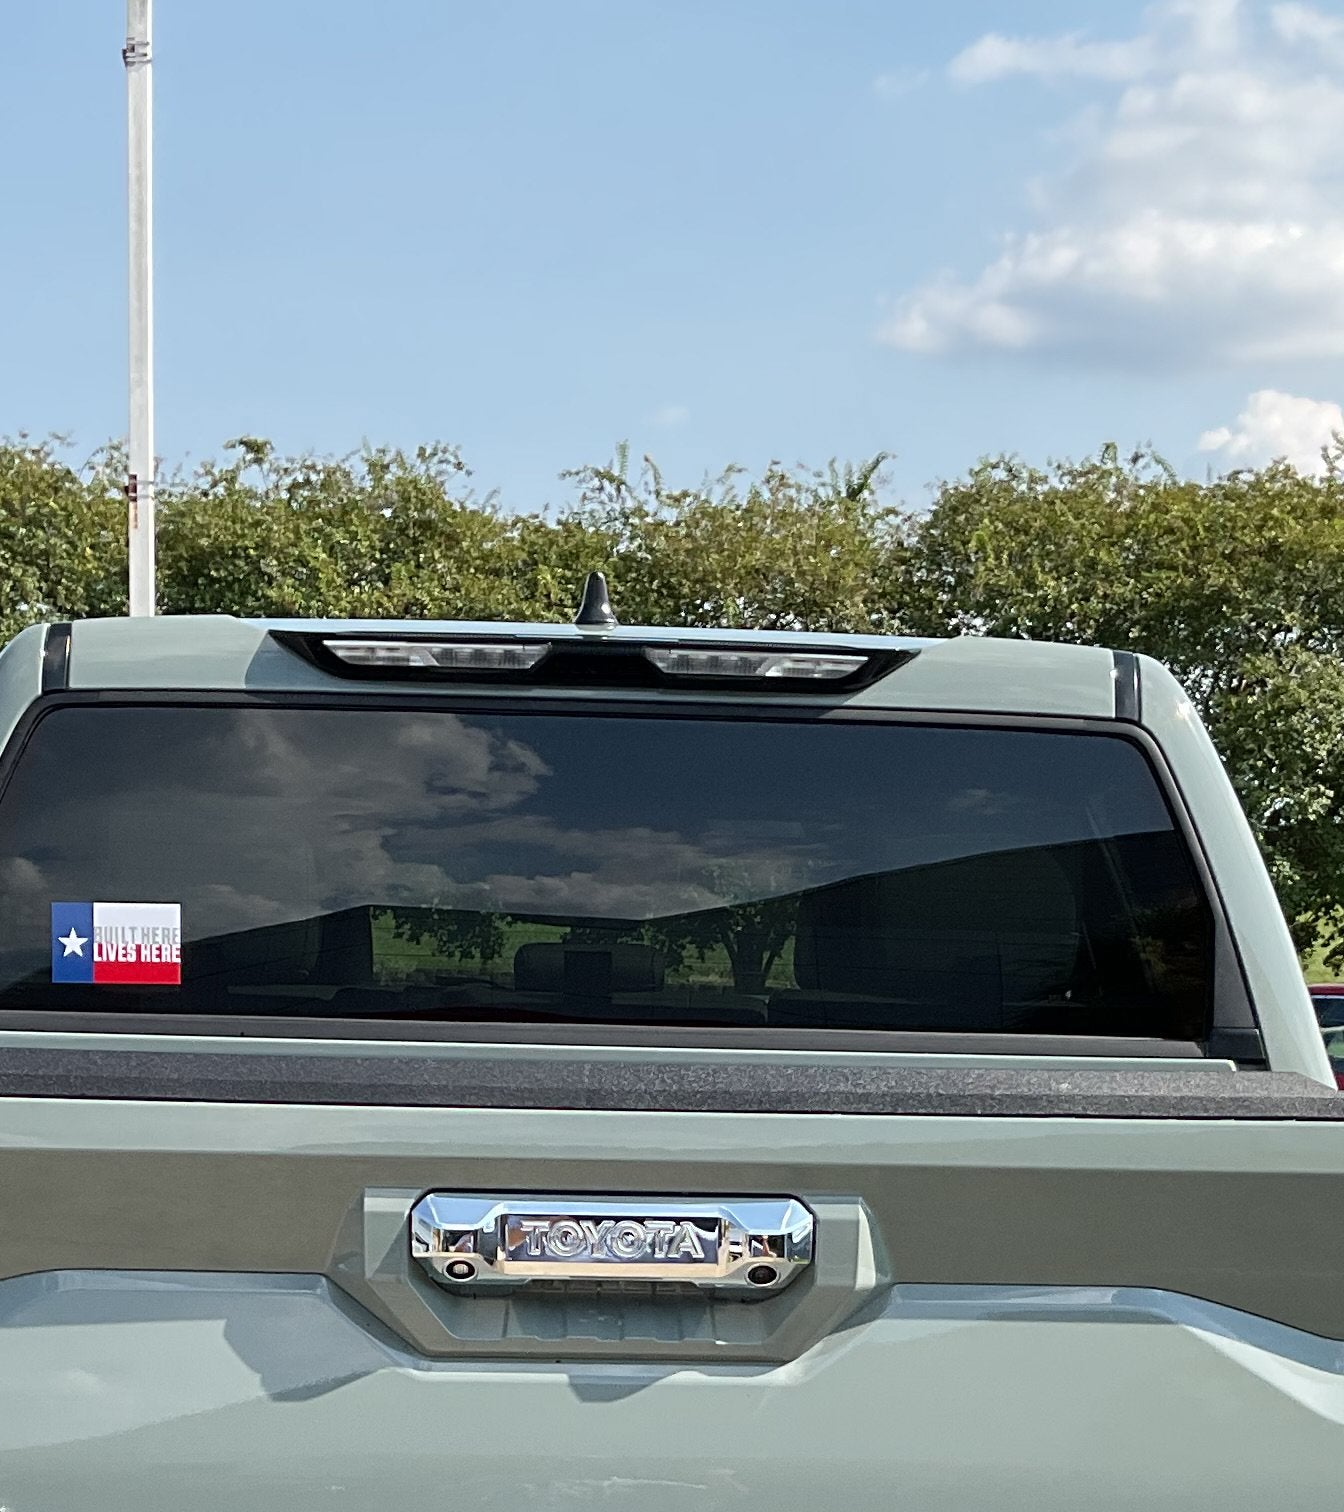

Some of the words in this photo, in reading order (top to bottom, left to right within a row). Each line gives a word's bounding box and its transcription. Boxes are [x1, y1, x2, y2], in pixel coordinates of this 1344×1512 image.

[94, 926, 138, 945] BUILT
[141, 927, 180, 945] HERE
[93, 943, 137, 962] LIVES
[140, 944, 181, 963] HERE
[520, 1219, 706, 1261] TOYOTA
